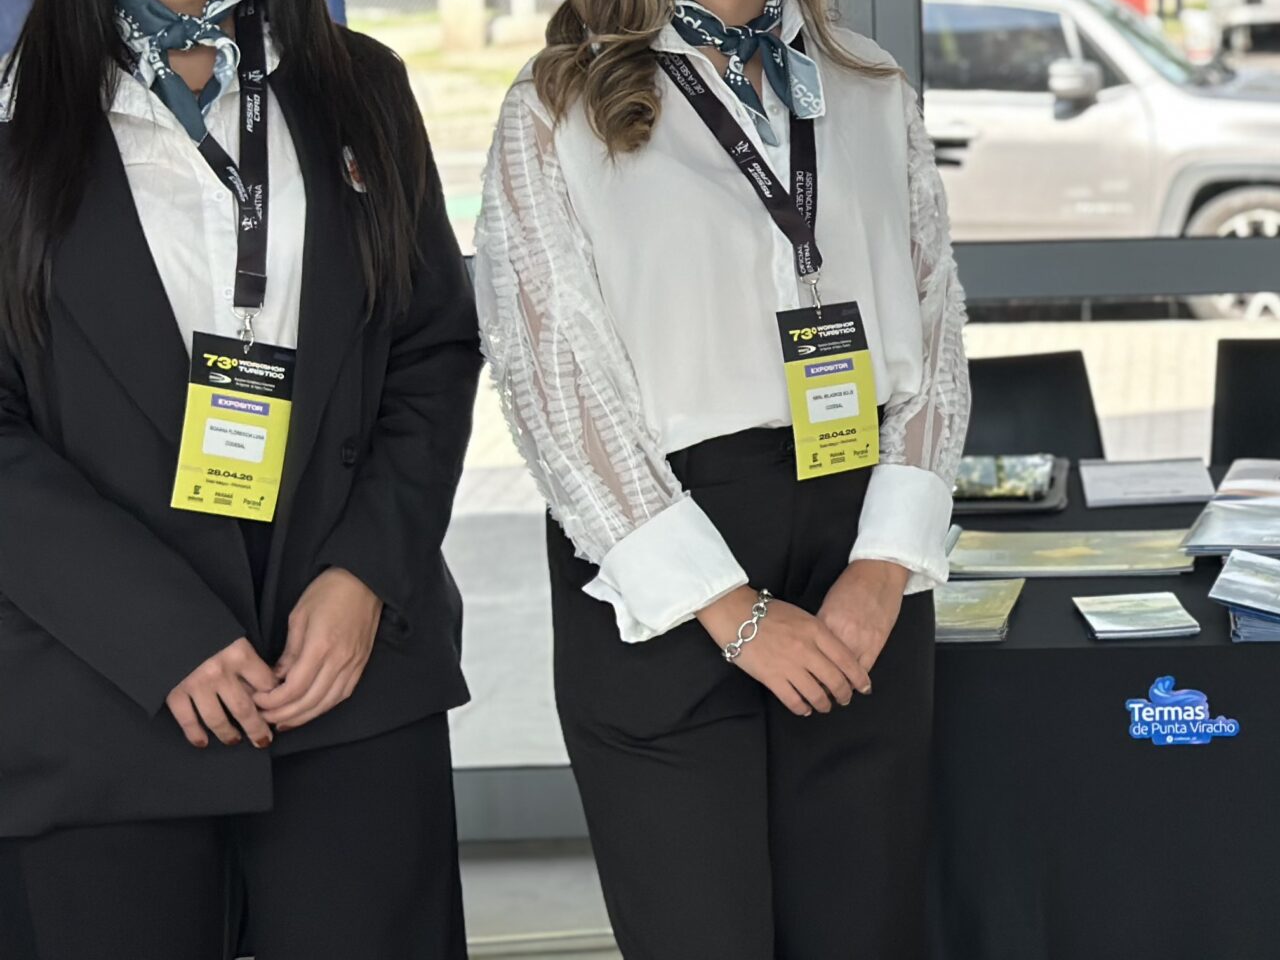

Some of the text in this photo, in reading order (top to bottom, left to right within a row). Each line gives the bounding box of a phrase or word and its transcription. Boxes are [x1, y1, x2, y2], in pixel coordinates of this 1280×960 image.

[686, 74, 698, 86] LA
[693, 82, 705, 95] DE
[752, 163, 772, 185] CARD
[796, 170, 803, 181] DE
[796, 182, 803, 194] LA
[817, 321, 854, 331] WORKSHOP
[810, 362, 848, 374] EXPOSITOR
[218, 398, 263, 412] EXPOSITOR
[819, 428, 857, 441] 28.04.26
[1129, 703, 1205, 722] Termas
[1133, 721, 1236, 735] de Punta Viracho
